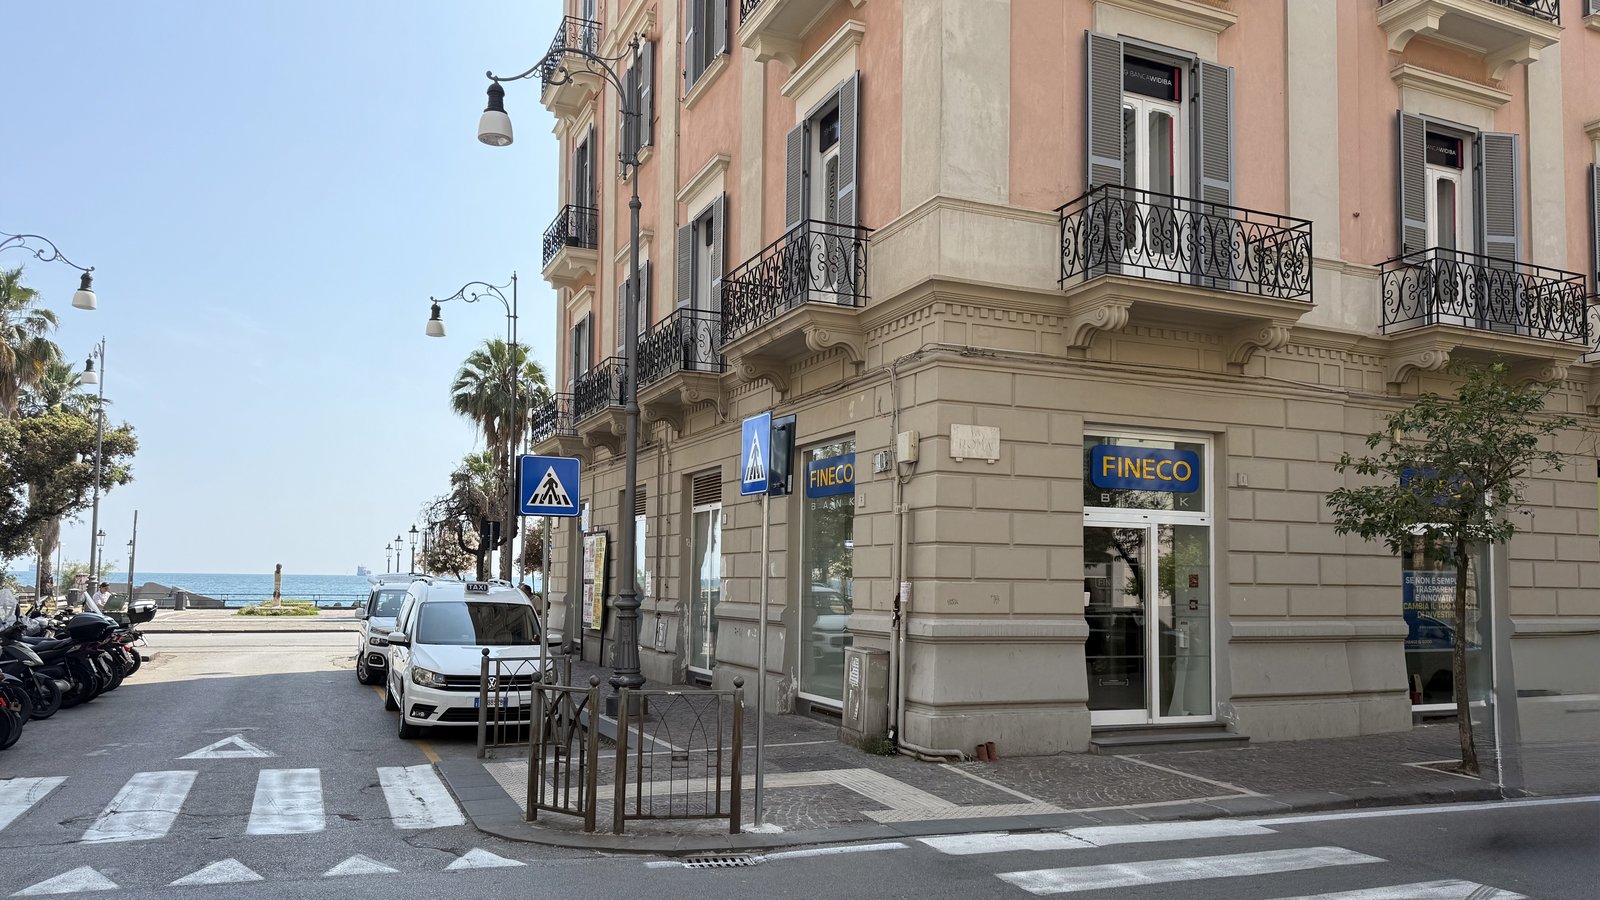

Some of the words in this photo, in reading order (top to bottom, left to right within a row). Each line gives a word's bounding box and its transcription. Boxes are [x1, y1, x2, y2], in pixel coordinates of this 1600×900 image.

[1129, 71, 1172, 86] BANCAWIDIBA
[1426, 144, 1456, 156] ANCAWIDIBA
[1102, 455, 1192, 482] FINECO
[810, 463, 854, 488] FINECO
[810, 497, 855, 511] BANK
[1101, 493, 1189, 507] BANK
[1405, 576, 1414, 584] SE
[1415, 576, 1430, 585] NON
[1436, 577, 1457, 585] SEMPL
[468, 583, 487, 591] TAXI
[1415, 585, 1457, 593] TRASPARENT
[1420, 594, 1457, 602] INNOVATIV
[1403, 602, 1429, 610] CAMBIA
